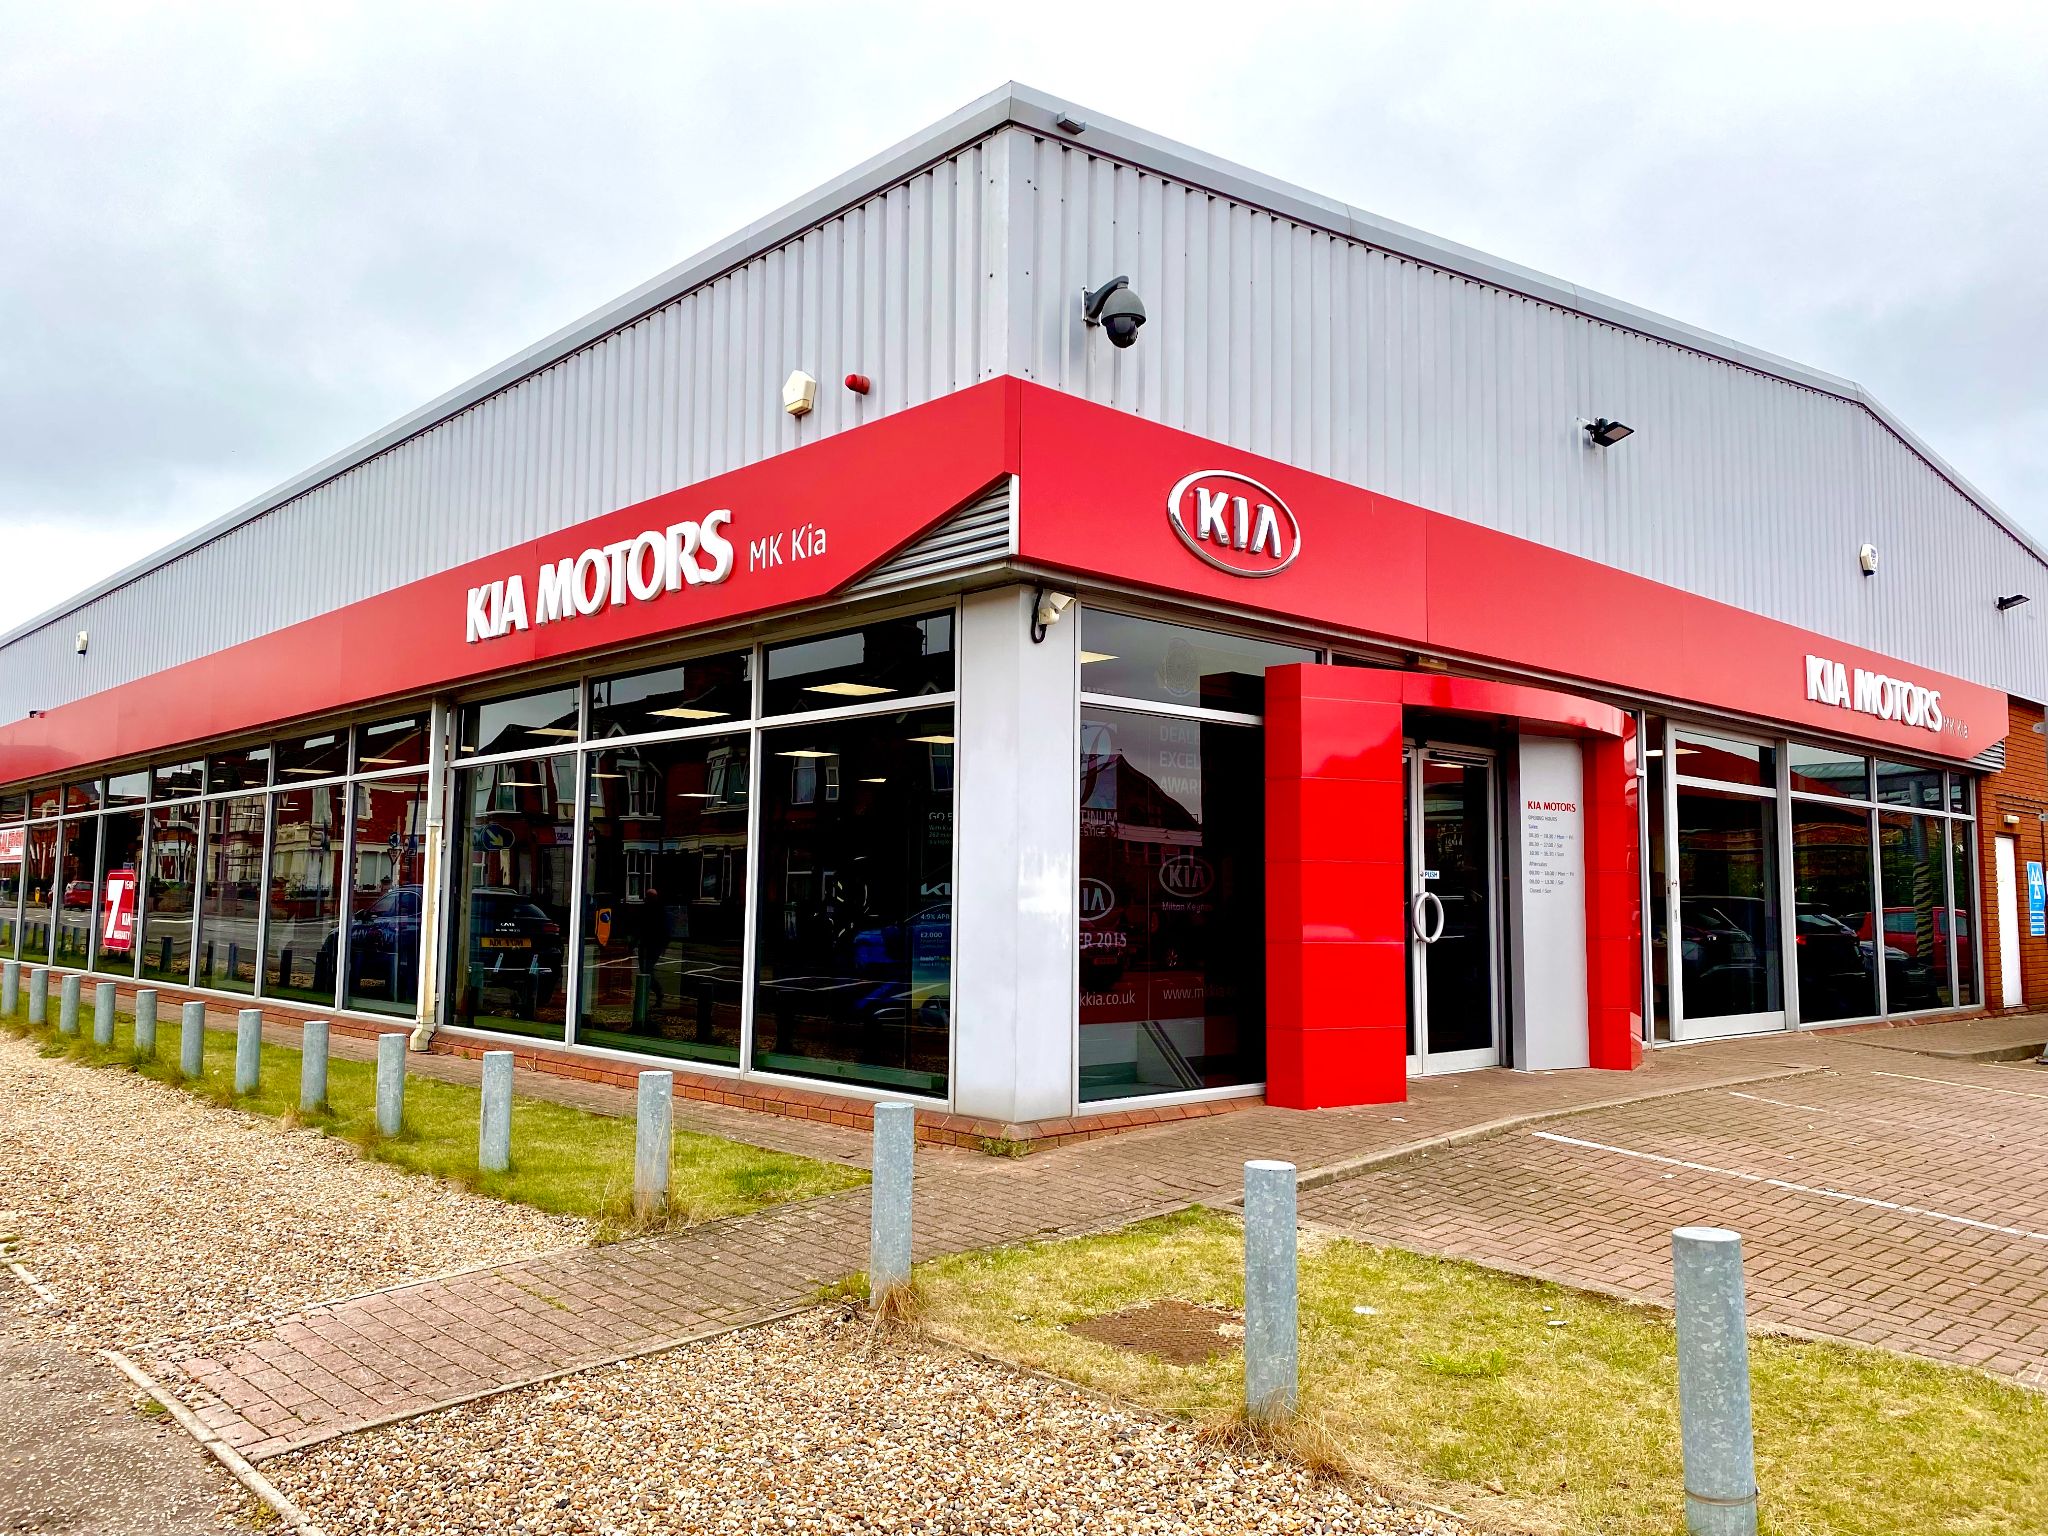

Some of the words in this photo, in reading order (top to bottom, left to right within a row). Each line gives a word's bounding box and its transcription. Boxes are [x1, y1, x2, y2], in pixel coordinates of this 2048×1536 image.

[1195, 487, 1281, 559] KIA
[466, 574, 528, 644] KIA
[535, 509, 734, 626] MOTORS
[749, 532, 782, 573] MK
[791, 523, 826, 561] Kia
[1805, 654, 1851, 709] KIA
[1853, 668, 1942, 732] MOTORS
[1527, 800, 1541, 810] KIA
[1543, 802, 1576, 813] MOTORS
[1083, 888, 1105, 910] IA
[1169, 865, 1205, 888] KIA
[105, 880, 124, 938] 7
